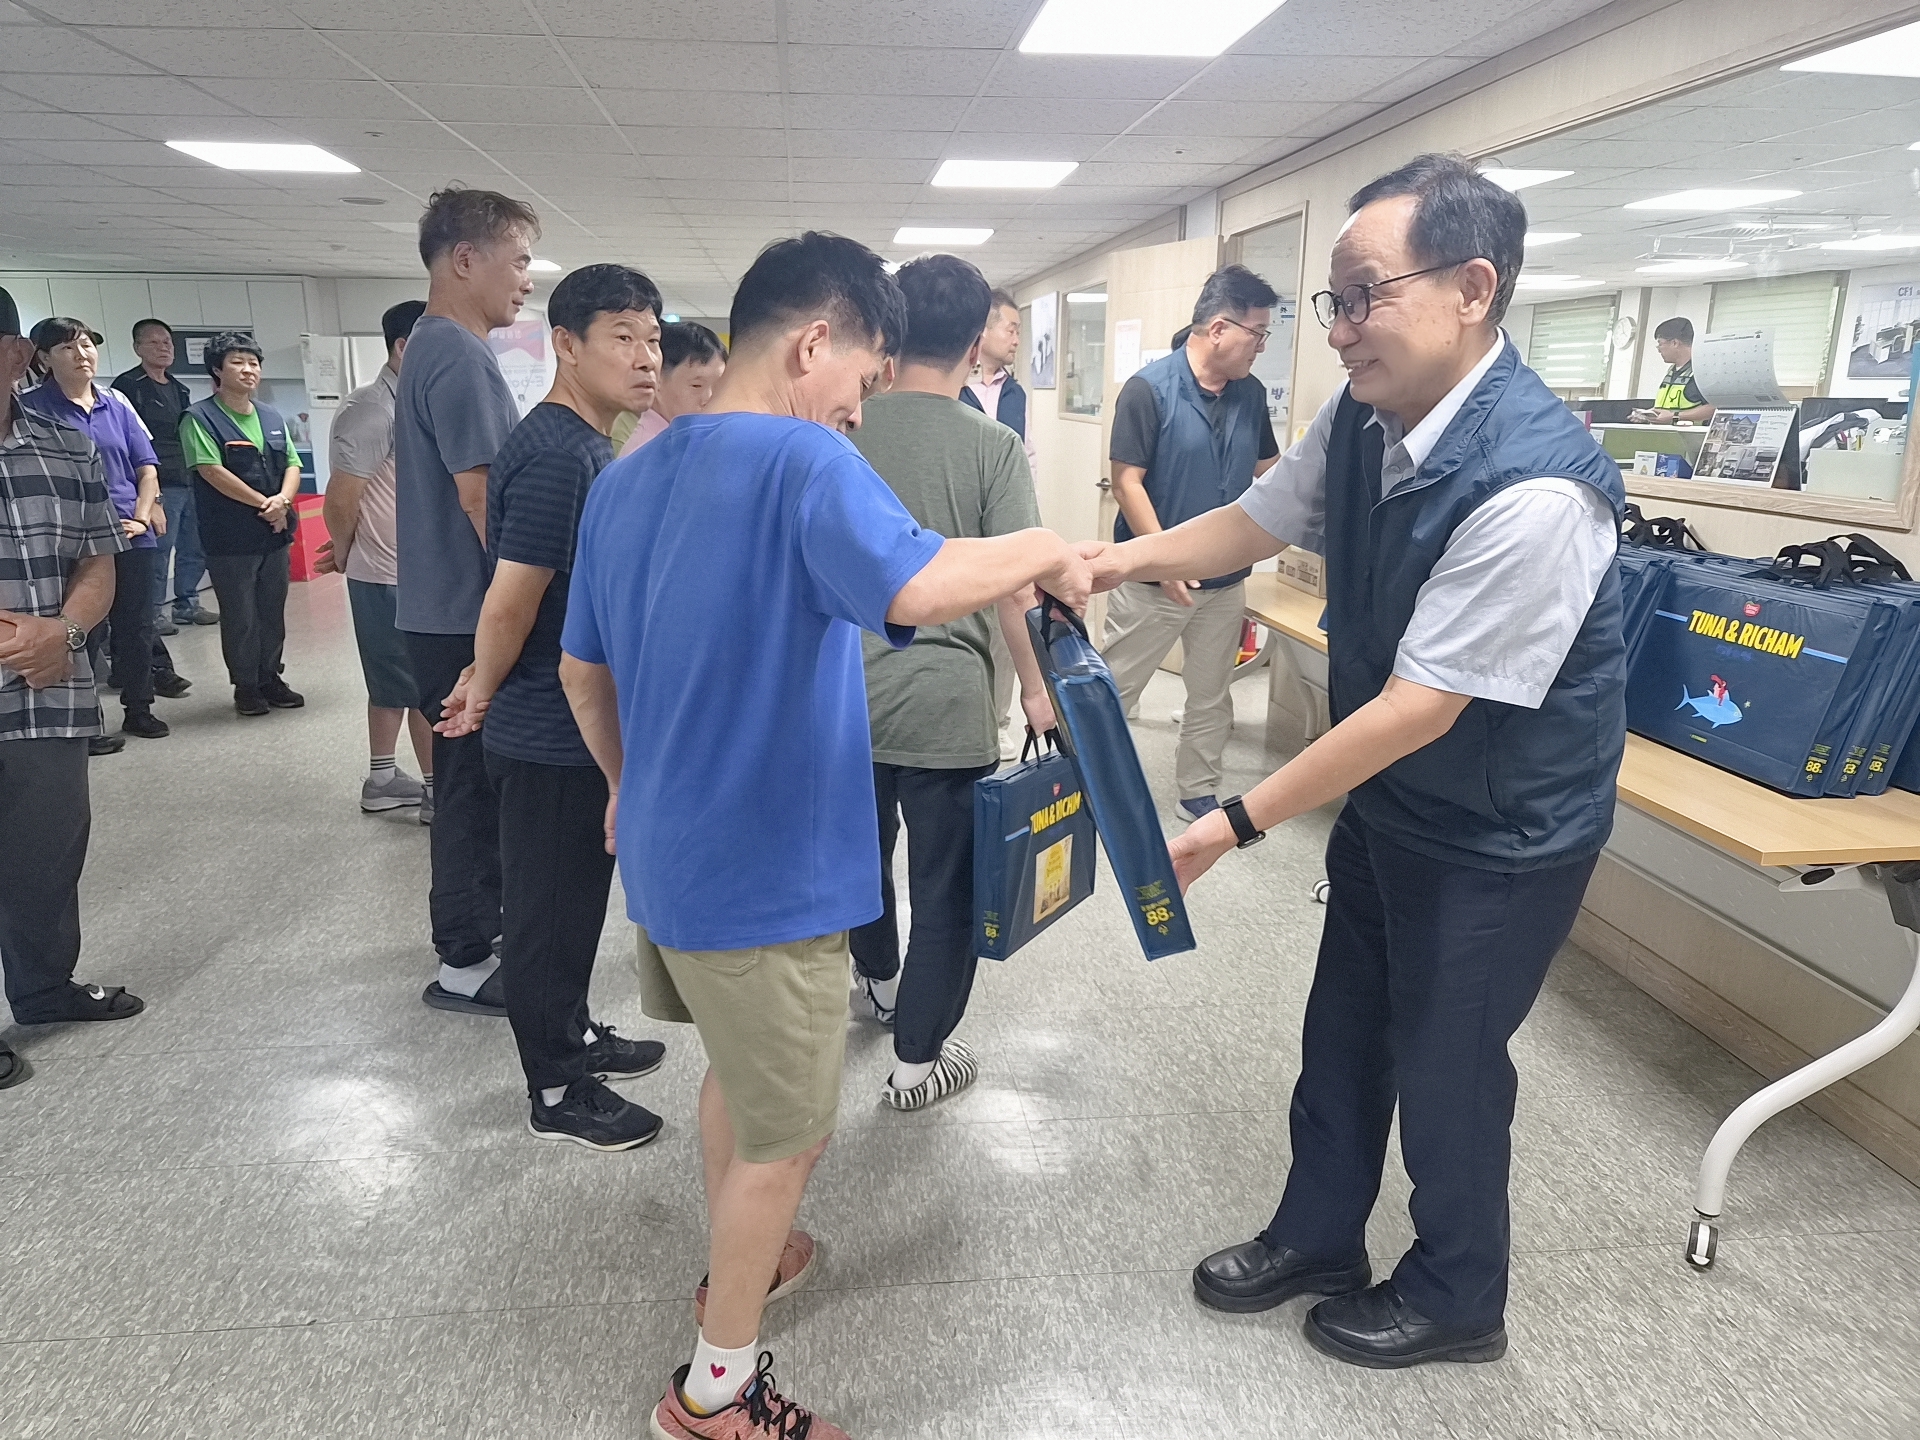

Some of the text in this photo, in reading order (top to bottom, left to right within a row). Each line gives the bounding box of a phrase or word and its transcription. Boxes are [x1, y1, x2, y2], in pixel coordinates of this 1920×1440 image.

[1688, 609, 1728, 640] TUNA
[1724, 619, 1740, 643] &
[1737, 622, 1804, 660] RICHAM
[1145, 906, 1170, 926] 88
